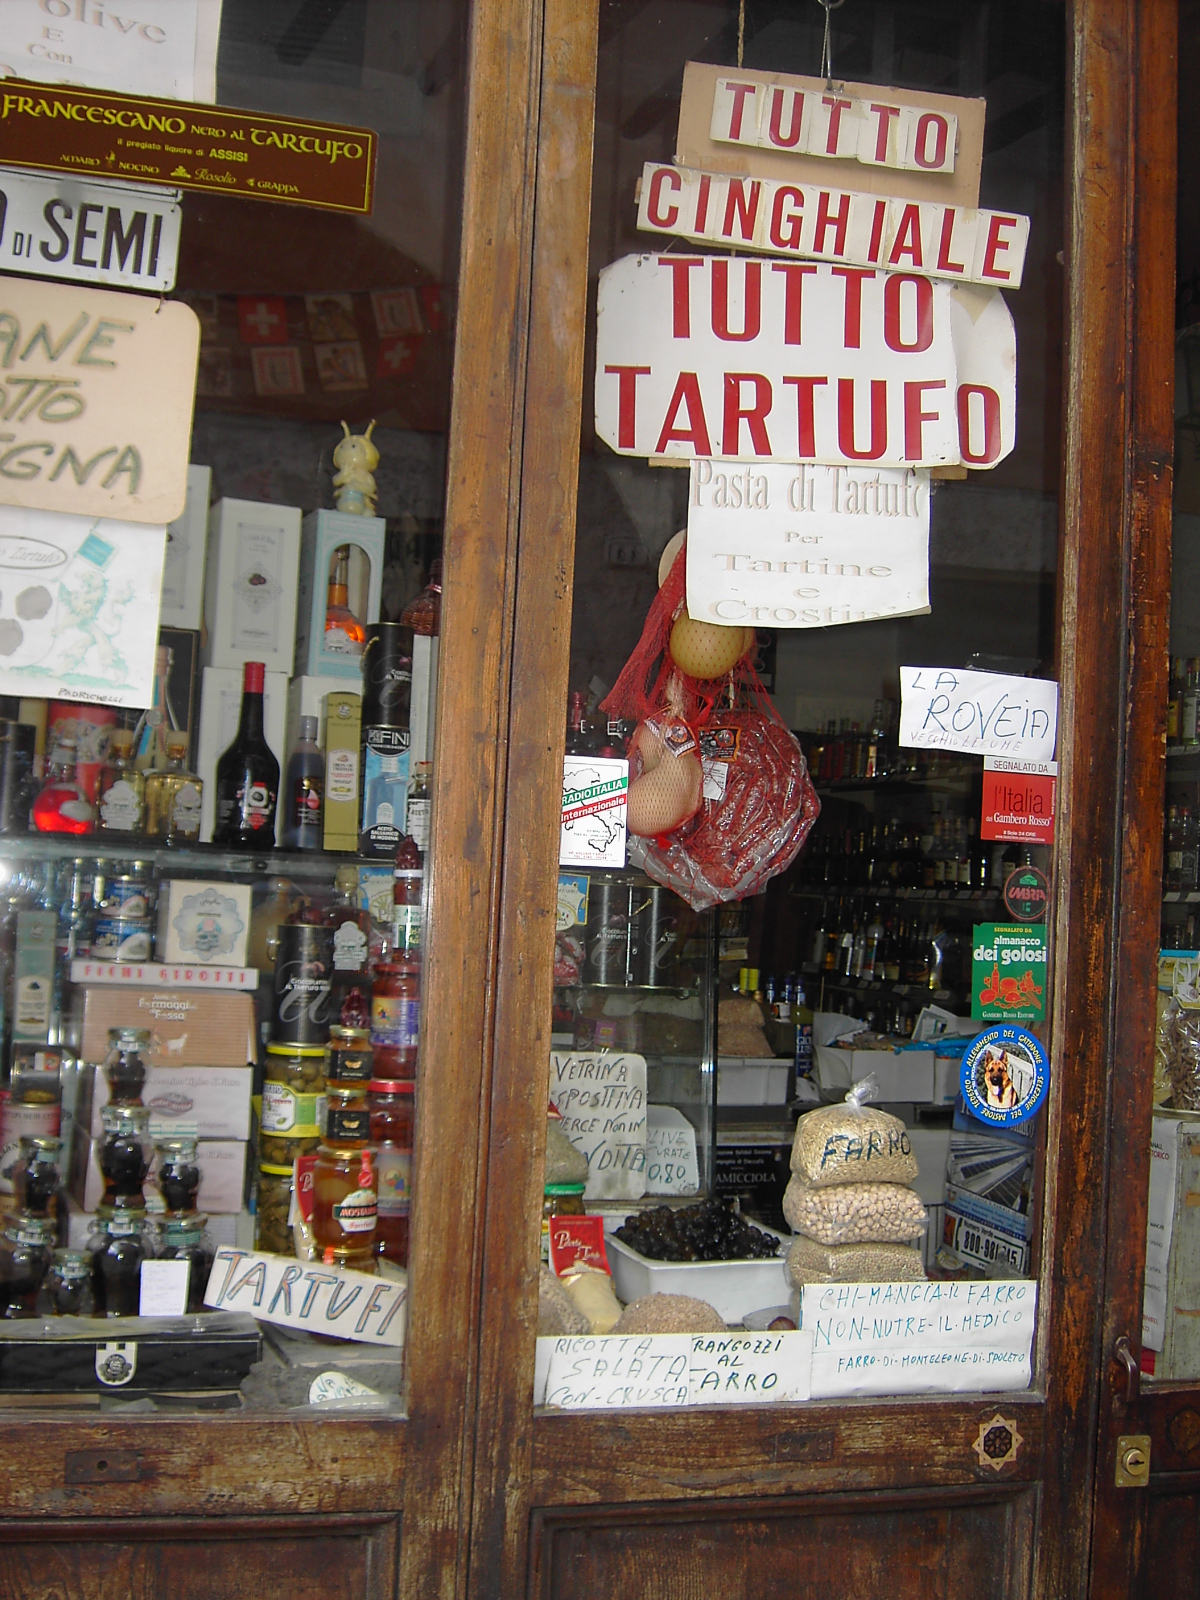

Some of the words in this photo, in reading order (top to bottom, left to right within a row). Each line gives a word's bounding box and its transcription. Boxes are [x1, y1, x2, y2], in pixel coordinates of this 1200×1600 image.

[42, 25, 65, 42] E
[25, 43, 74, 64] Con
[2, 94, 187, 134] FRANCESCANO
[190, 124, 227, 138] NERO
[229, 128, 246, 141] AL
[249, 127, 364, 164] TARTUFO
[725, 82, 949, 169] TUTTO
[126, 139, 163, 151] pregiato
[164, 144, 193, 156] liquore
[195, 148, 204, 156] di
[208, 147, 249, 162] ASSISI
[118, 160, 161, 174] NOCINO
[194, 167, 238, 184] Rosolio
[257, 180, 300, 194] GRAPPA
[647, 167, 1018, 281] CINGHIALE
[12, 231, 32, 258] DI
[39, 197, 163, 277] SEMI
[658, 256, 934, 353] TUTTO
[0, 375, 84, 423] TTO
[604, 364, 1001, 464] TARTUFO
[0, 433, 142, 495] GNA
[691, 459, 771, 511] Pasta
[787, 463, 816, 512] di
[784, 531, 824, 545] Per
[712, 553, 893, 577] Tartine
[792, 585, 821, 599] e
[911, 672, 960, 692] LA
[381, 730, 409, 747] FINI
[993, 760, 1037, 773] SEGNALATO
[1038, 764, 1049, 773] DA
[562, 789, 592, 806] RADIO
[592, 780, 623, 797] ITALIA
[993, 785, 1044, 814] l'Italia
[561, 796, 625, 823] Internazionale
[994, 812, 1027, 825] Gambero
[993, 935, 1041, 946] almanacco
[973, 944, 999, 962] dei
[1000, 945, 1047, 965] golosi
[84, 965, 144, 980] FICHI
[159, 967, 247, 983] GIROTTI
[138, 997, 190, 1011] Formaggi
[154, 1011, 185, 1020] Fossa
[966, 1031, 999, 1067] ALLEVAMENTO
[1003, 1029, 1015, 1038] DEL
[555, 1056, 628, 1082] VETRINA
[552, 1085, 643, 1110] SPOSITIVA
[964, 1079, 981, 1108] TEDESCO
[1025, 1075, 1044, 1110] SELEZIONE
[1010, 1109, 1023, 1119] DEL
[647, 1130, 688, 1146] LIVE
[821, 1128, 911, 1169] FARRO
[981, 1227, 994, 1238] Verde
[217, 1250, 407, 1336] TARTUFI
[966, 1285, 1027, 1306] FARRO
[554, 1337, 653, 1354] RICOTTA
[562, 1354, 687, 1383] SALATA
[717, 1354, 744, 1367] AL
